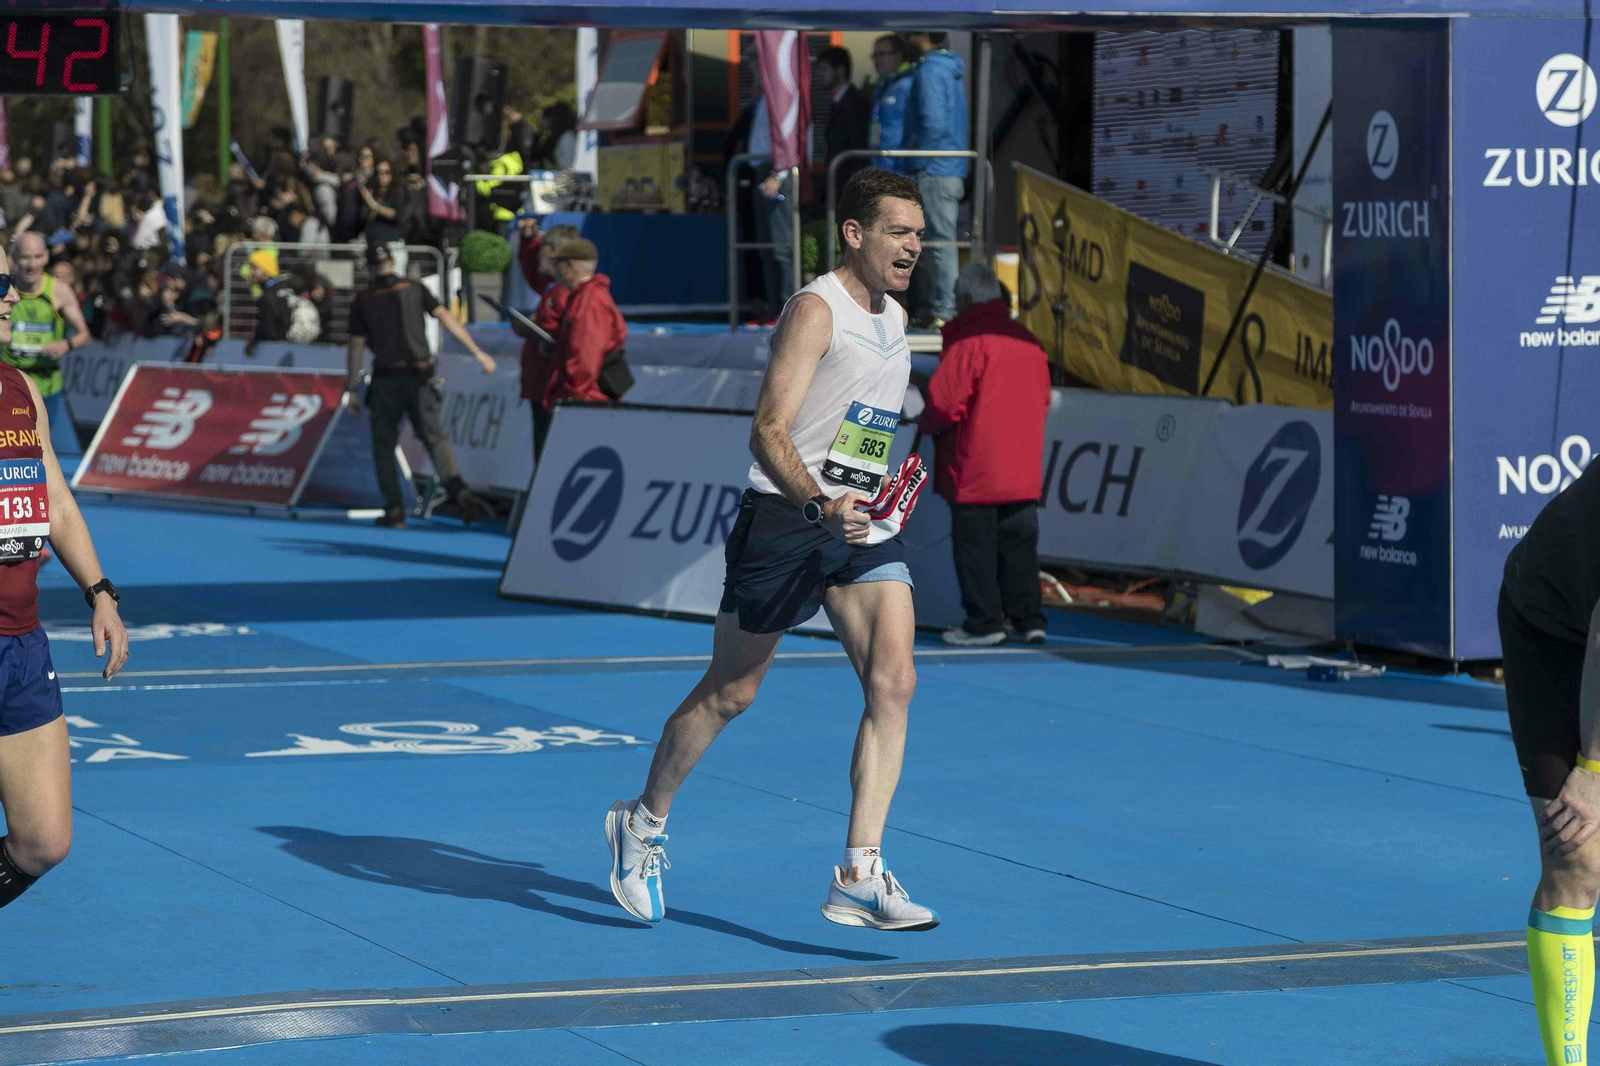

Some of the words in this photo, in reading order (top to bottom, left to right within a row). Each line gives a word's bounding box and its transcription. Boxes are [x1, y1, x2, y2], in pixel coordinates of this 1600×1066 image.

[6, 19, 110, 92] 42
[1342, 201, 1430, 238] ZURICH
[1520, 331, 1555, 347] new
[1296, 331, 1333, 390] IM
[445, 391, 507, 450] RICH
[859, 437, 886, 459] 583
[98, 453, 126, 474] new
[126, 453, 191, 482] balance
[200, 464, 231, 483] new
[231, 463, 296, 487] balance
[1360, 544, 1378, 560] new
[1379, 544, 1417, 566] balance
[1562, 946, 1577, 1042] COMPRESSPORT
